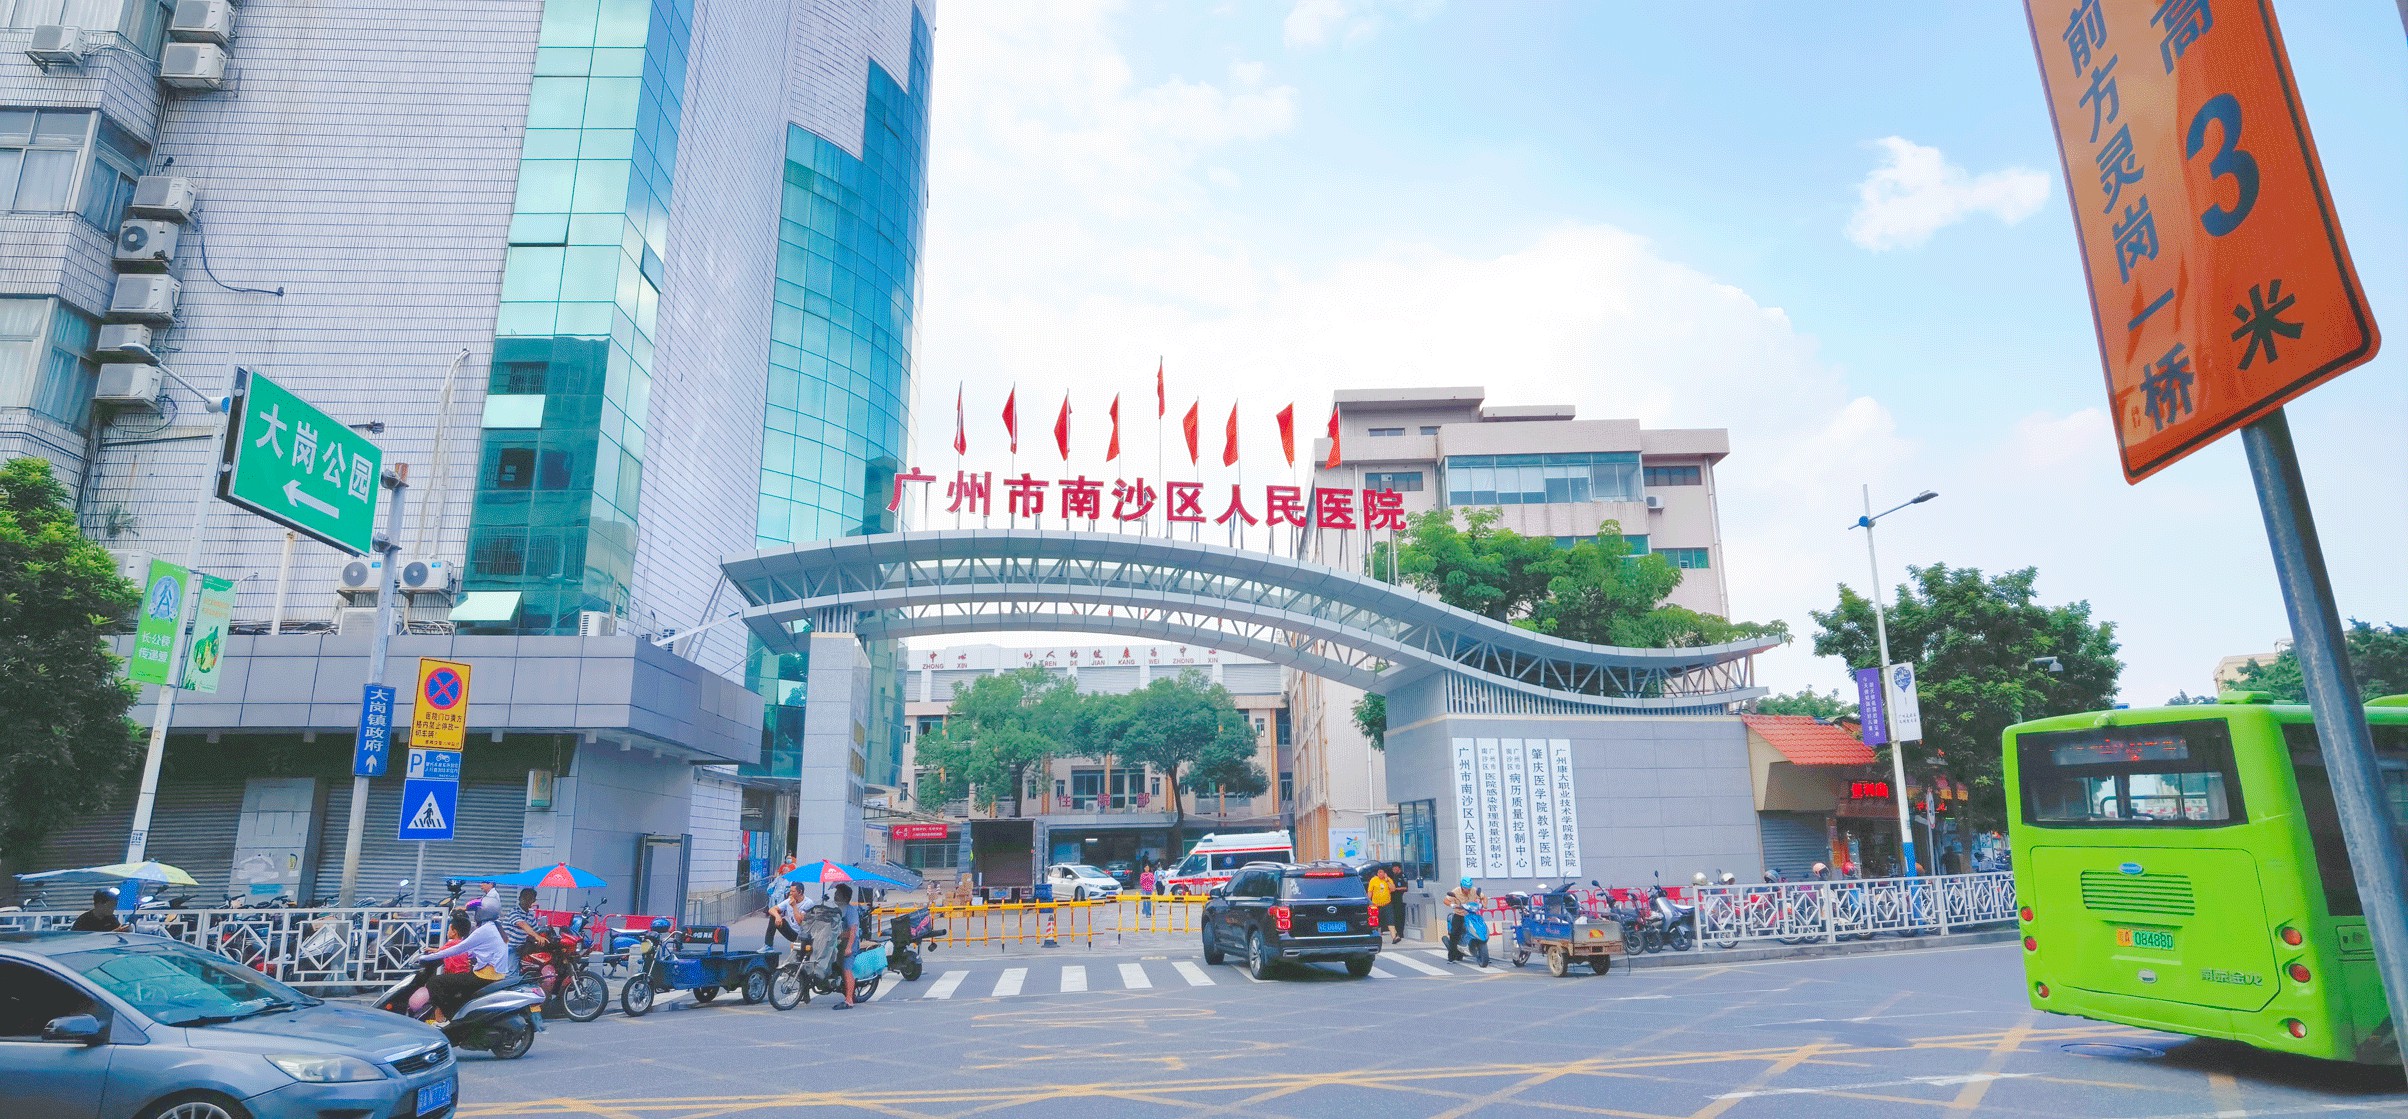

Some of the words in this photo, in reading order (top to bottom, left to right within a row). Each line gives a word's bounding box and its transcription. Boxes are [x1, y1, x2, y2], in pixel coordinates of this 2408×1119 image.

[2062, 0, 2195, 432] 前方灵岗一桥
[256, 403, 373, 504] 大岗公园
[886, 466, 1408, 531] 广州市南沙区人民医院
[364, 688, 389, 752] 大岗镇政府
[410, 753, 423, 773] P
[1058, 793, 1150, 808] 住院部
[1458, 747, 1478, 868] 广州市南沙区人民医院
[1485, 772, 1503, 869] 医院感染管理质量控制中心
[1509, 773, 1528, 868] 病历质量控制中心
[1531, 748, 1552, 867] 肇庆医学院教学医院
[1555, 748, 1577, 867] 广州康大职业技术学院教学医院
